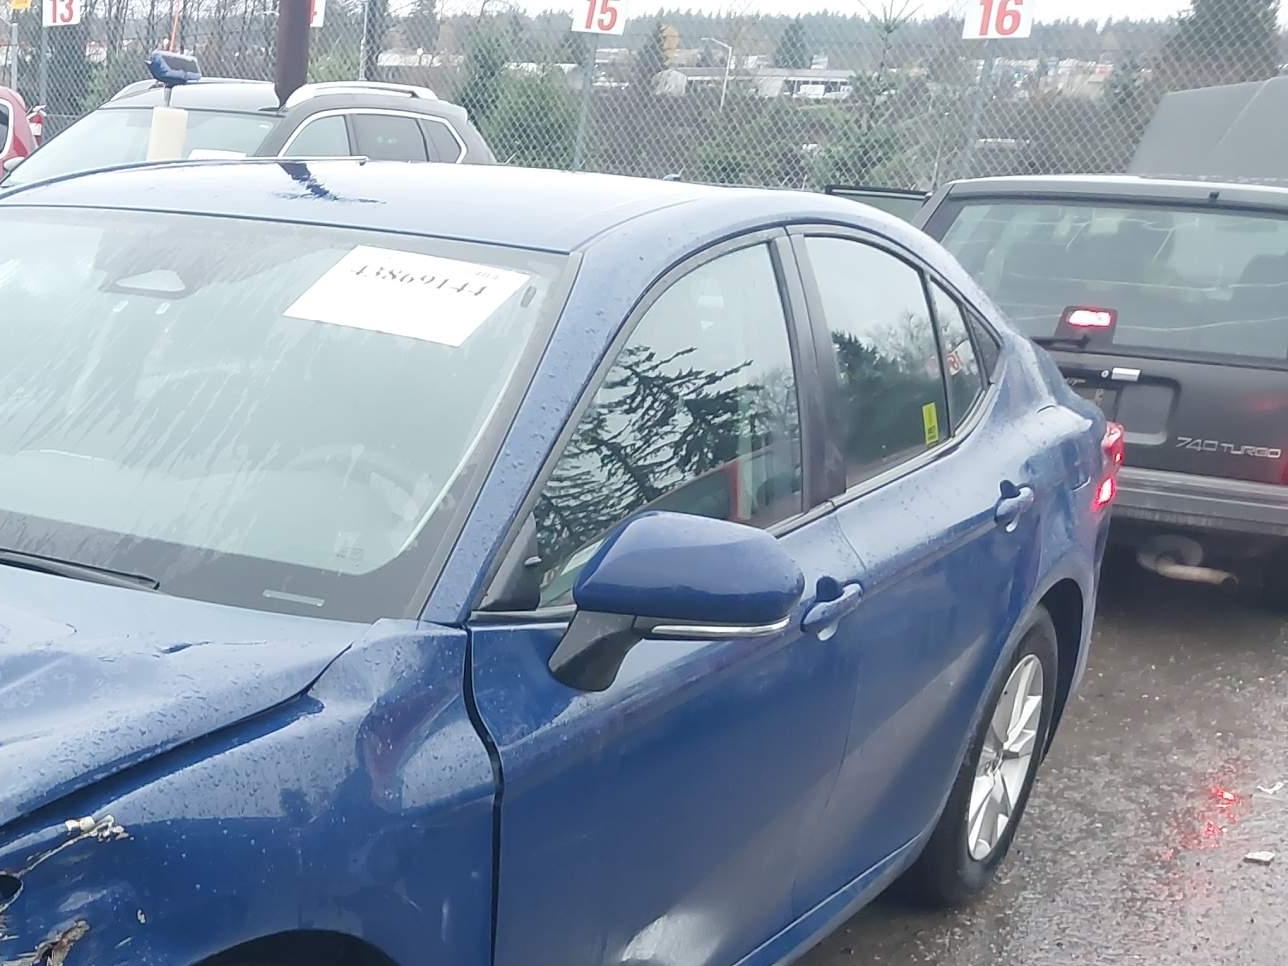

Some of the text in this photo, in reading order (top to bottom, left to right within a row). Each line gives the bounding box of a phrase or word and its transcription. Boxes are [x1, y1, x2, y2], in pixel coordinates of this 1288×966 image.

[51, 0, 74, 23] 13
[584, 0, 618, 31] 15
[978, 0, 1024, 36] 16
[1175, 435, 1282, 459] 740 TURBO
